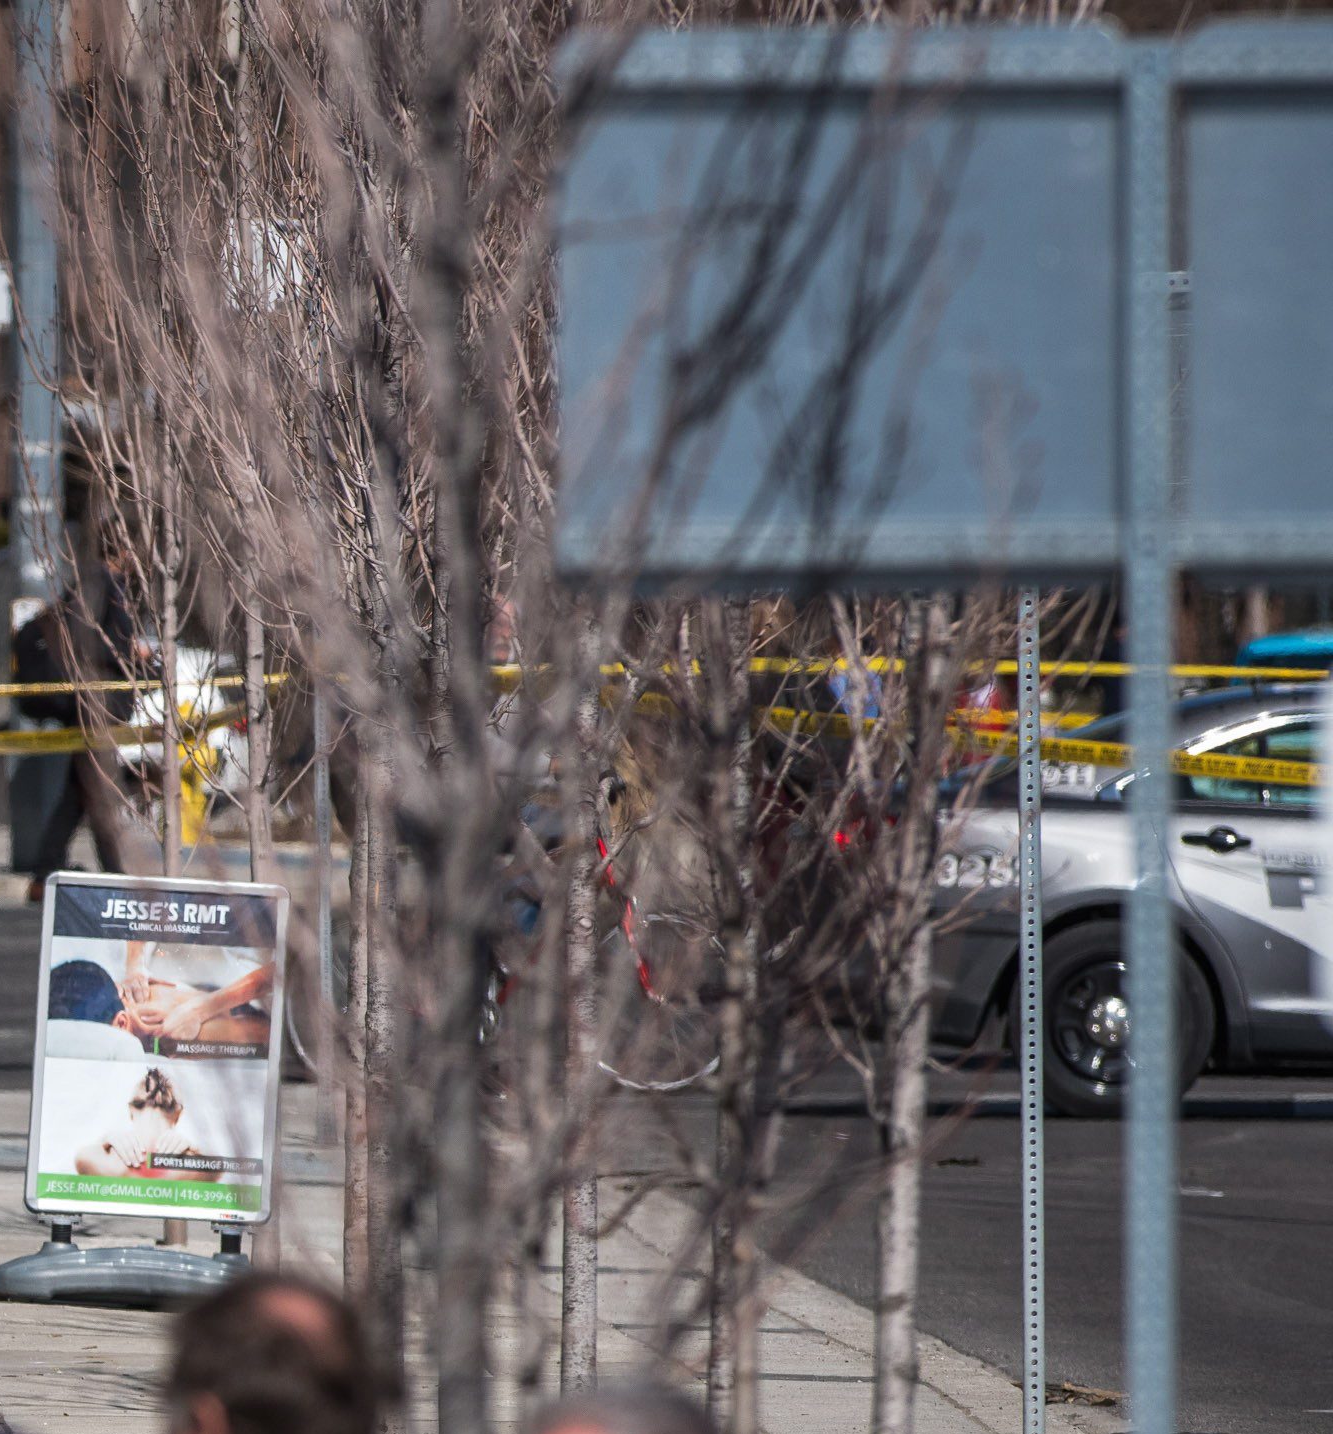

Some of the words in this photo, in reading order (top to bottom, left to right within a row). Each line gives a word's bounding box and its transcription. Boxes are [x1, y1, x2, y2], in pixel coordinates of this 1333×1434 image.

[936, 852, 1020, 889] 325
[101, 898, 179, 922] JESSE'S
[183, 903, 231, 925] RMT
[128, 921, 163, 933] CLINICAL
[164, 923, 202, 935] MASSAGE
[176, 1042, 216, 1054] MASSAGE
[153, 1156, 183, 1168] SPORTS
[183, 1158, 222, 1171] MASSAGE
[46, 1180, 174, 1200] JESSE.RMT@GMAIL.COM
